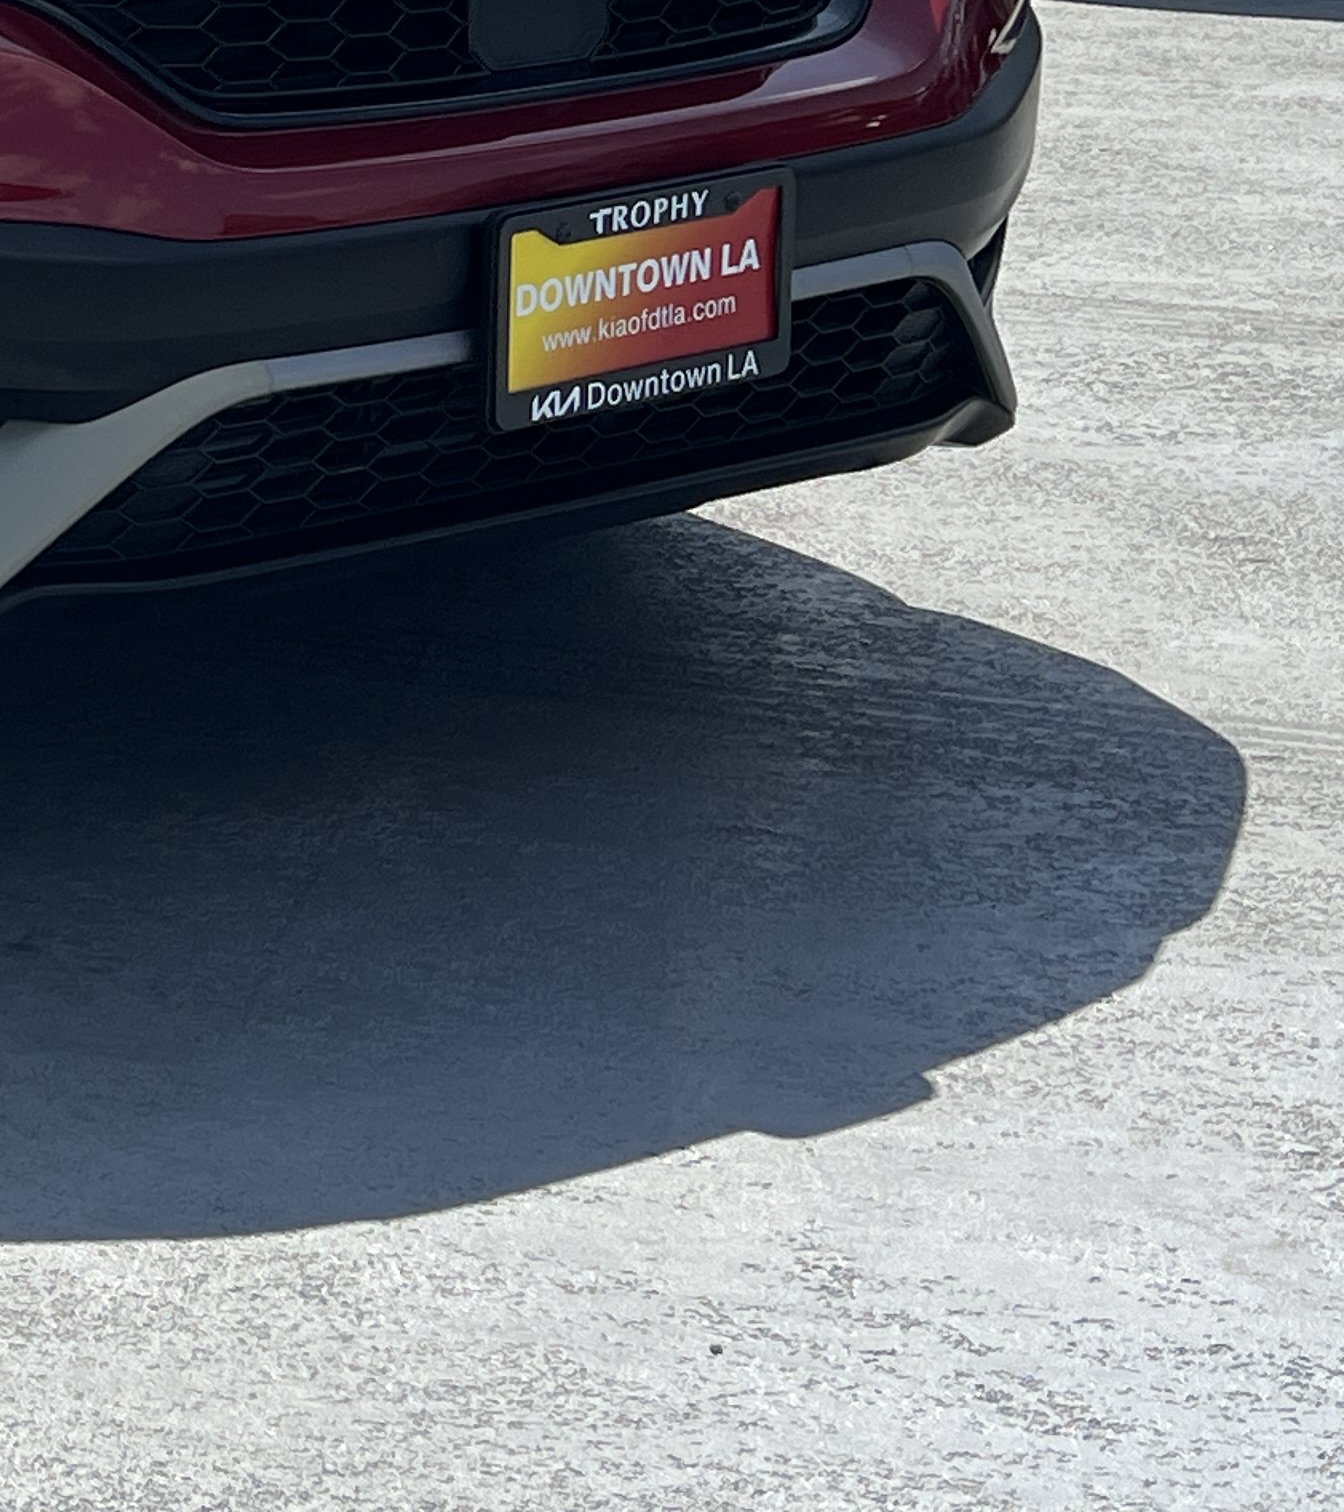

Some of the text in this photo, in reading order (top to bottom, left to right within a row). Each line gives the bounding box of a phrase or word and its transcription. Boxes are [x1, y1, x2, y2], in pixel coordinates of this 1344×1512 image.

[590, 190, 710, 235] TROPHY
[516, 240, 760, 317] DOWNTOWN LA
[543, 295, 736, 352] www.kiaofdtla.com
[531, 351, 759, 422] KIA Downtown LA
